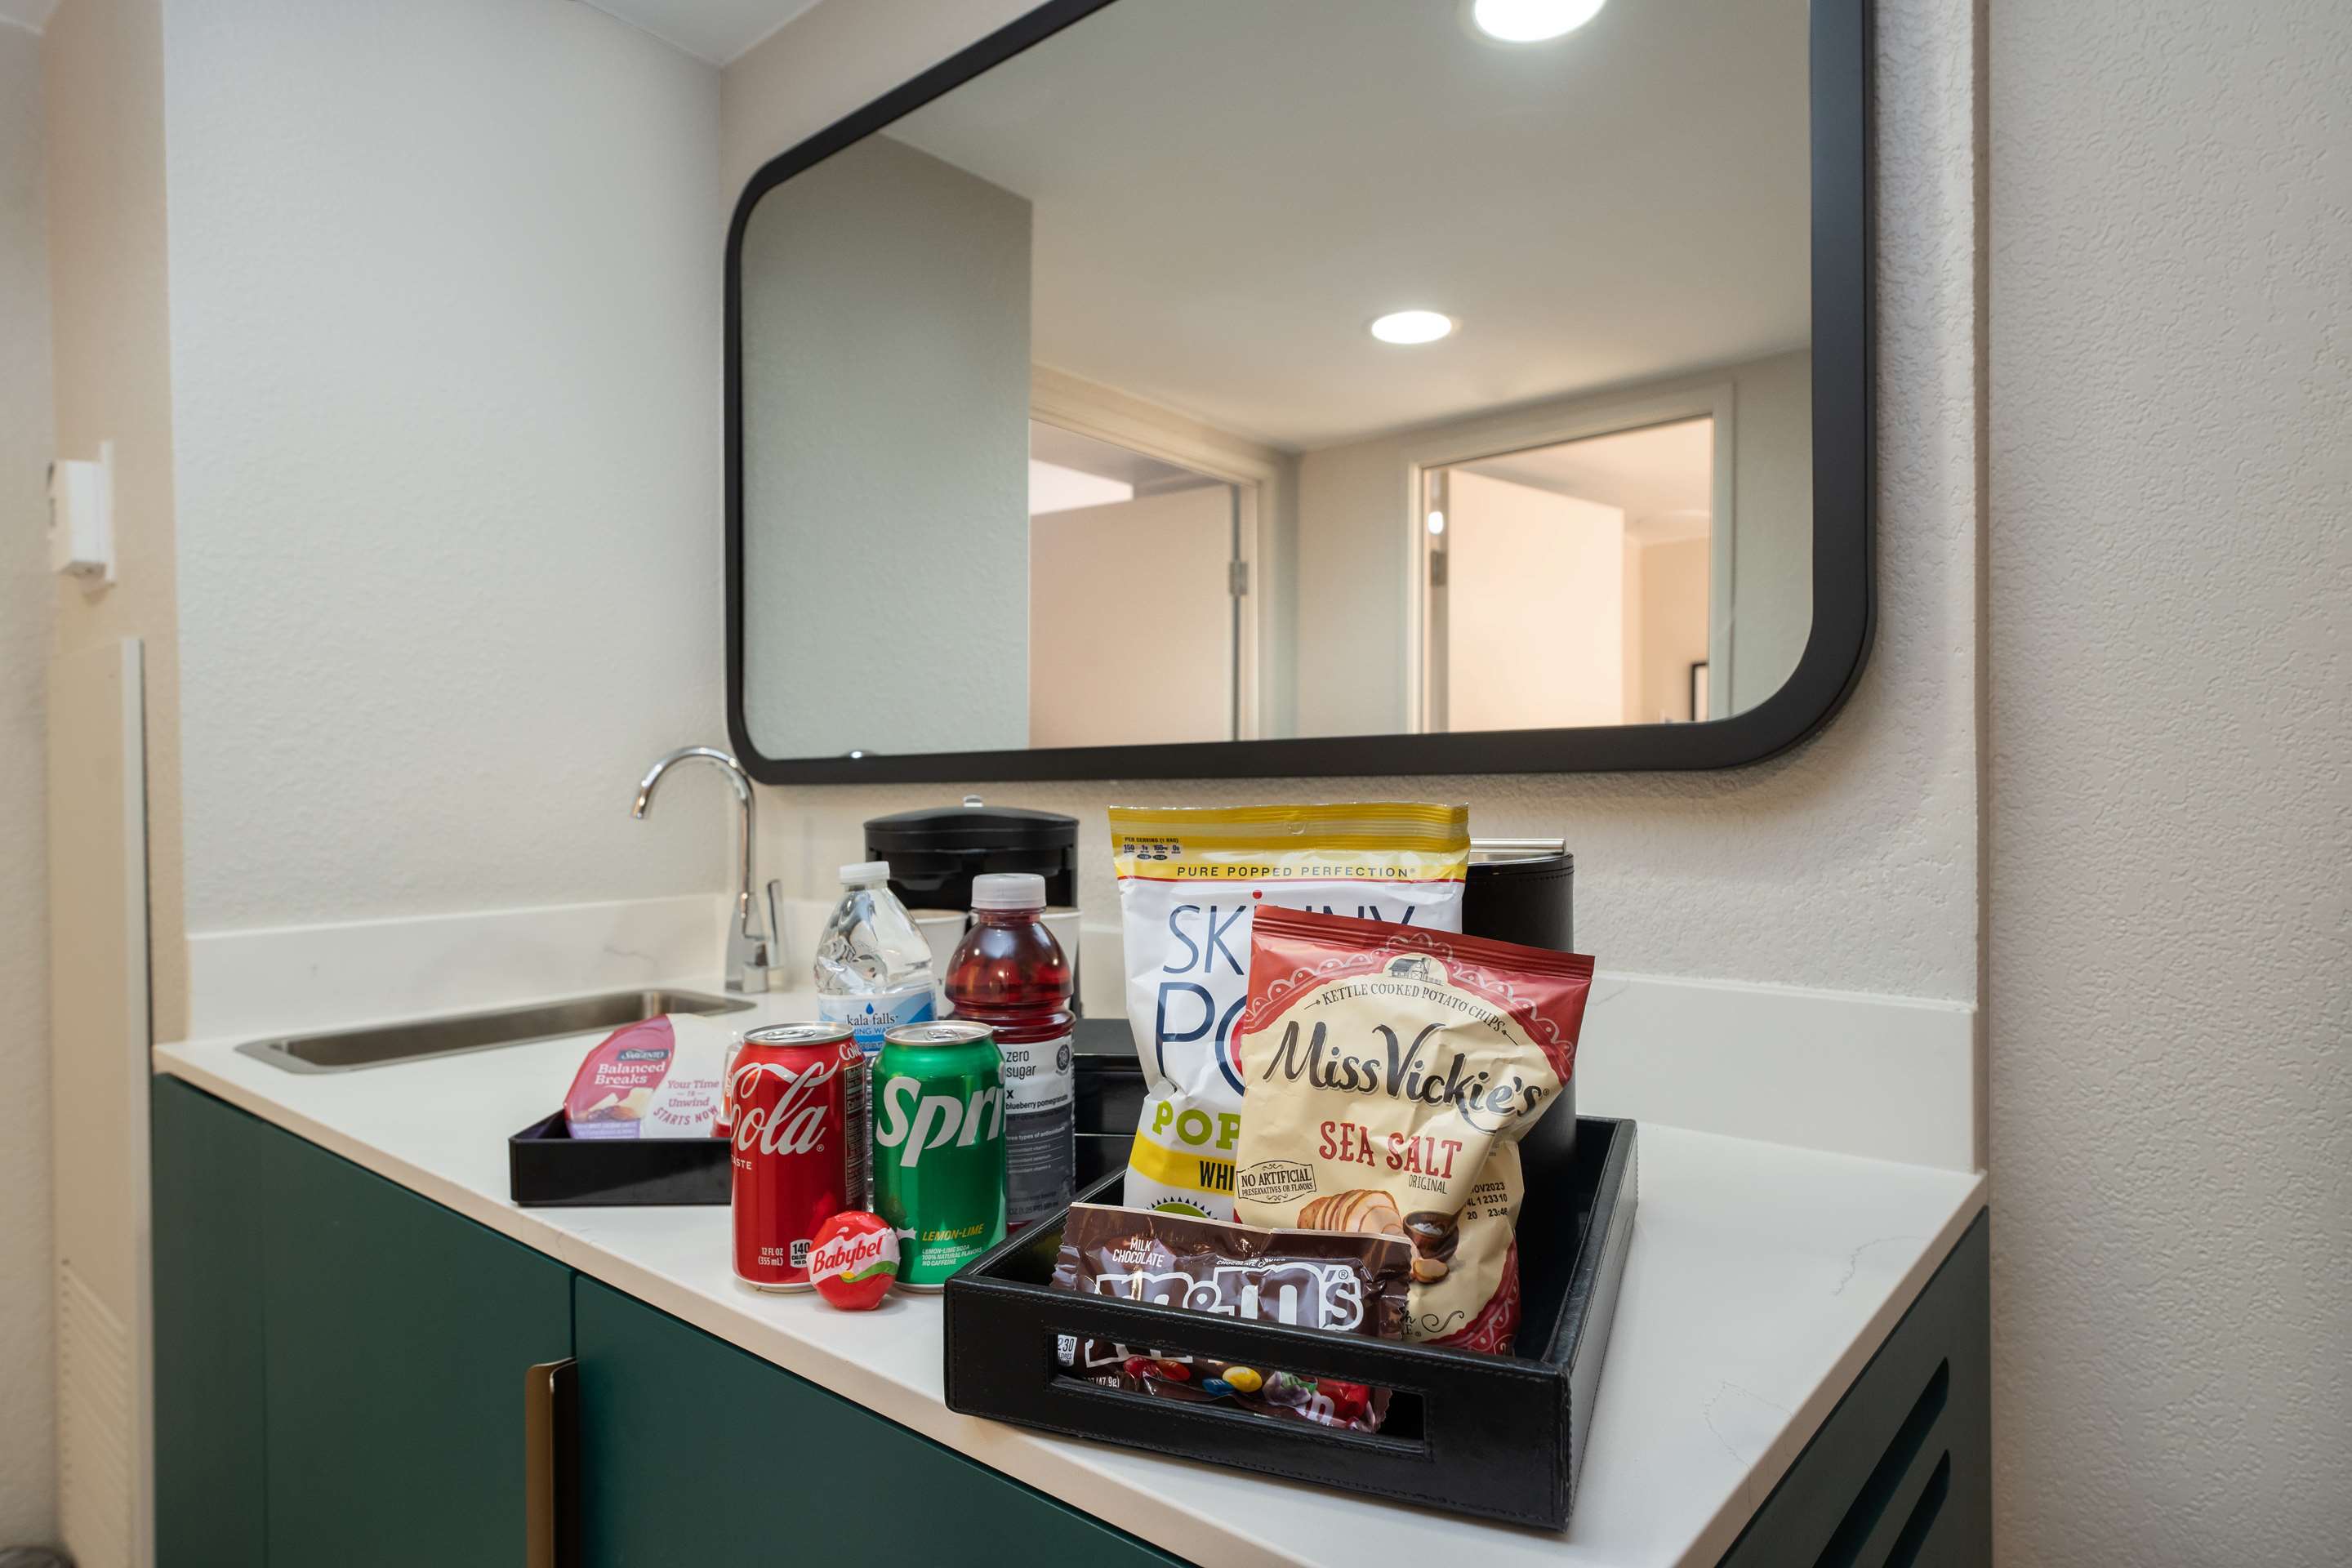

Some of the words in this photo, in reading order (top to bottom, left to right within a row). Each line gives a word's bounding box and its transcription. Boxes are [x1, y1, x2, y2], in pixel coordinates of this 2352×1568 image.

[1177, 866, 1218, 876] PURE
[1227, 866, 1292, 877] POPPED
[1321, 983, 1368, 1005] KETTLE
[1370, 983, 1419, 997] COOKED
[1422, 987, 1469, 1012] POTATO
[1468, 1004, 1507, 1032] CHIPS
[846, 1013, 868, 1026] kala
[872, 1013, 895, 1025] falls
[1006, 1050, 1030, 1062] zero
[597, 1061, 666, 1074] Balanced
[1005, 1065, 1037, 1080] sugar
[595, 1074, 648, 1085] Breaks
[667, 1080, 692, 1089] Your
[693, 1079, 719, 1089] Time
[1262, 1020, 1381, 1094] Miss
[1372, 1022, 1544, 1136] Vickie's
[668, 1096, 710, 1107] Unwind
[653, 1107, 691, 1125] STARTS
[695, 1104, 719, 1123] NOW
[1318, 1120, 1375, 1167] SEA
[1385, 1131, 1463, 1180] SALT
[1200, 1160, 1234, 1192] WHI
[1241, 1174, 1256, 1187] NO
[1258, 1168, 1312, 1186] ARTIFICIAL
[1241, 1185, 1281, 1196] PRESERVATIVES
[1282, 1184, 1291, 1192] OR
[1291, 1182, 1313, 1192] FLAVORS
[1408, 1174, 1448, 1195] ORIGINAL
[1467, 1211, 1477, 1220] 20
[922, 1223, 984, 1241] LEMON-LIME
[792, 1242, 810, 1254] 140
[1129, 1236, 1152, 1252] MILK
[761, 1247, 767, 1255] 12
[768, 1247, 775, 1256] FL
[775, 1248, 784, 1256] OZ
[812, 1235, 884, 1275] Babybel
[1111, 1249, 1165, 1267] CHOCOLATE
[758, 1257, 771, 1266] (355
